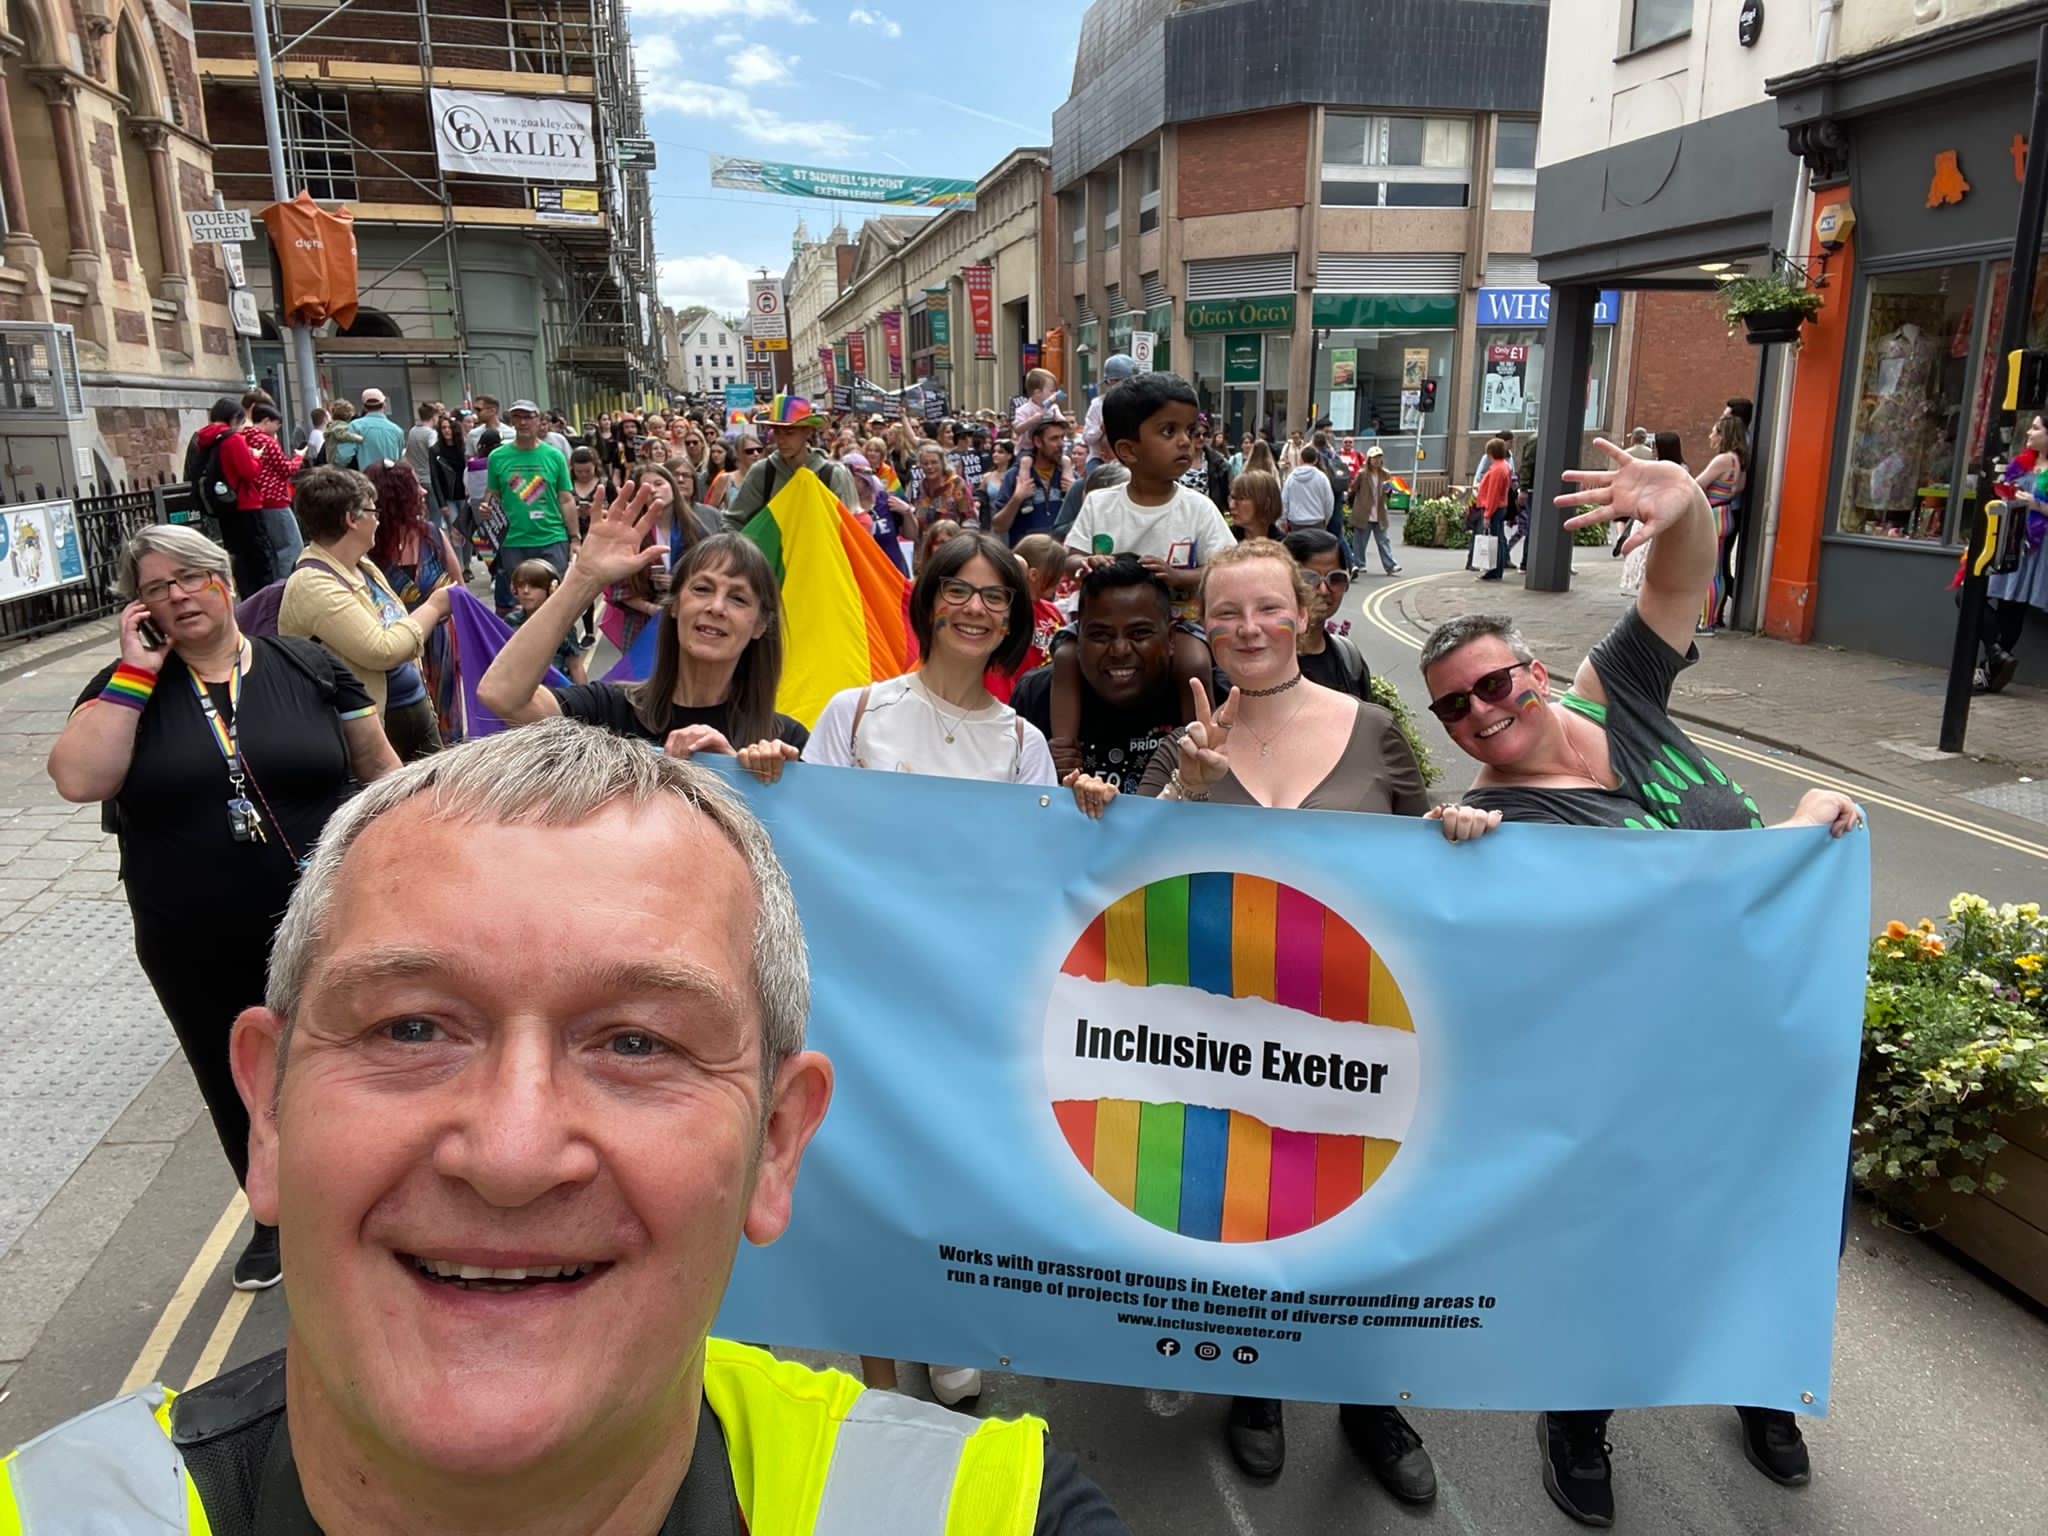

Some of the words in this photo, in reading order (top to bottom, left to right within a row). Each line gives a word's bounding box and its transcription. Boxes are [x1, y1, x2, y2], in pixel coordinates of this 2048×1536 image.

[493, 115, 585, 131] www.goakley.com
[793, 169, 807, 181] ST
[808, 171, 869, 187] SIDWELL'S
[870, 176, 904, 189] POINT
[814, 185, 849, 198] EXETER
[192, 212, 247, 226] QUEEN
[194, 226, 249, 240] STREET
[1240, 304, 1290, 324] OGGY
[1510, 346, 1523, 359] £1
[1075, 1018, 1252, 1076] Inclusive
[1262, 1040, 1389, 1094] Exeter
[939, 1244, 993, 1266] Works
[997, 1253, 1034, 1272] with
[1037, 1258, 1121, 1284] grassroot
[1125, 1273, 1187, 1292] groups
[1191, 1277, 1208, 1294] in
[1212, 1280, 1268, 1302] Exeter
[1271, 1290, 1305, 1305] and
[1309, 1293, 1420, 1310] surrounding
[1423, 1296, 1474, 1309] areas
[1477, 1295, 1496, 1309] to
[947, 1268, 976, 1285] run
[979, 1272, 989, 1286] a
[993, 1275, 1043, 1294] range
[1046, 1281, 1064, 1296] of
[1067, 1285, 1139, 1306] projects
[1142, 1293, 1169, 1309] for
[1171, 1296, 1200, 1313] the
[1203, 1301, 1268, 1319] benefit
[1271, 1308, 1289, 1321] of
[1292, 1310, 1358, 1326] diverse
[1362, 1314, 1484, 1329] communities.
[1117, 1312, 1302, 1342] www.inclusiveexeter.org
